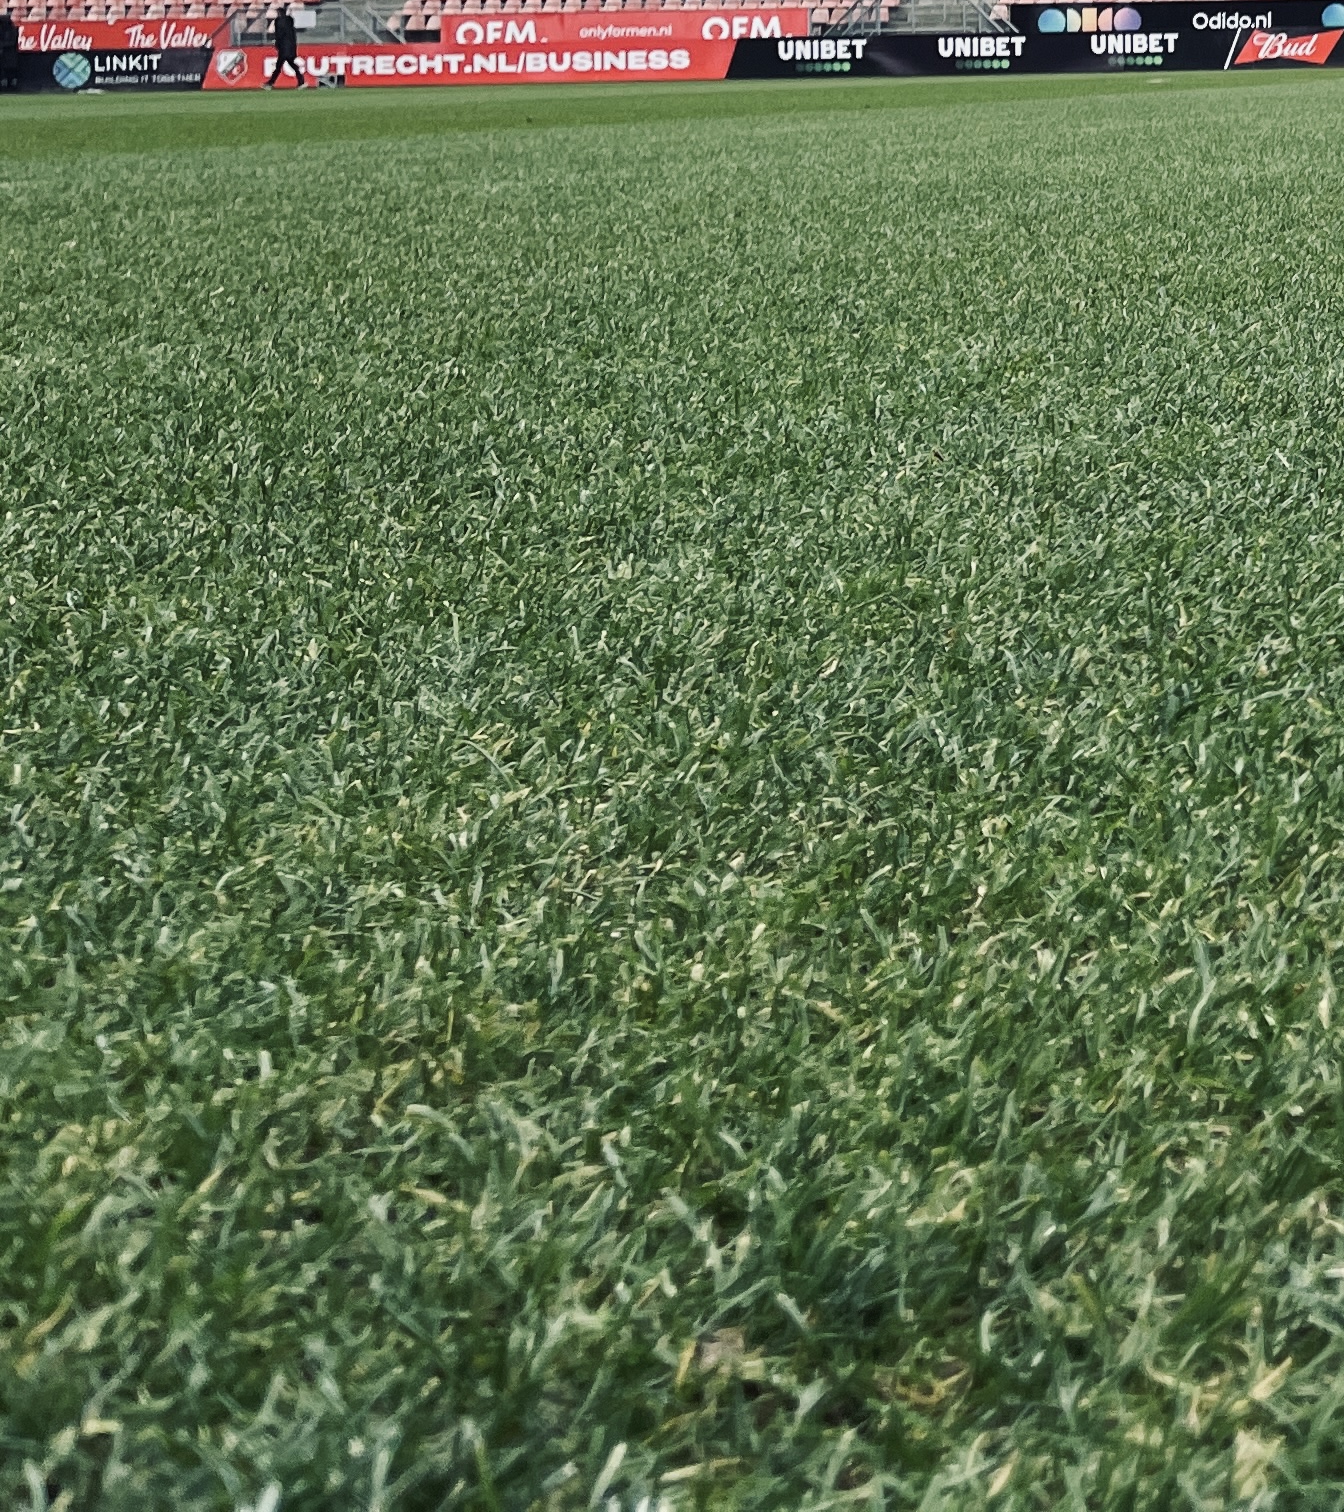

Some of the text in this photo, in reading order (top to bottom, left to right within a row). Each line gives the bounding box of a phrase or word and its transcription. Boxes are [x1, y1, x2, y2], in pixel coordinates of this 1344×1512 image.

[579, 24, 673, 40] onlyformen.nl
[1192, 10, 1273, 30] Odido.nl
[17, 25, 37, 51] he
[125, 24, 158, 48] The
[938, 35, 1027, 59] UNIBET
[1090, 32, 1179, 55] UNIBET
[1253, 32, 1318, 59] Bud
[778, 38, 868, 62] UNIBET
[94, 53, 162, 72] LINKIT
